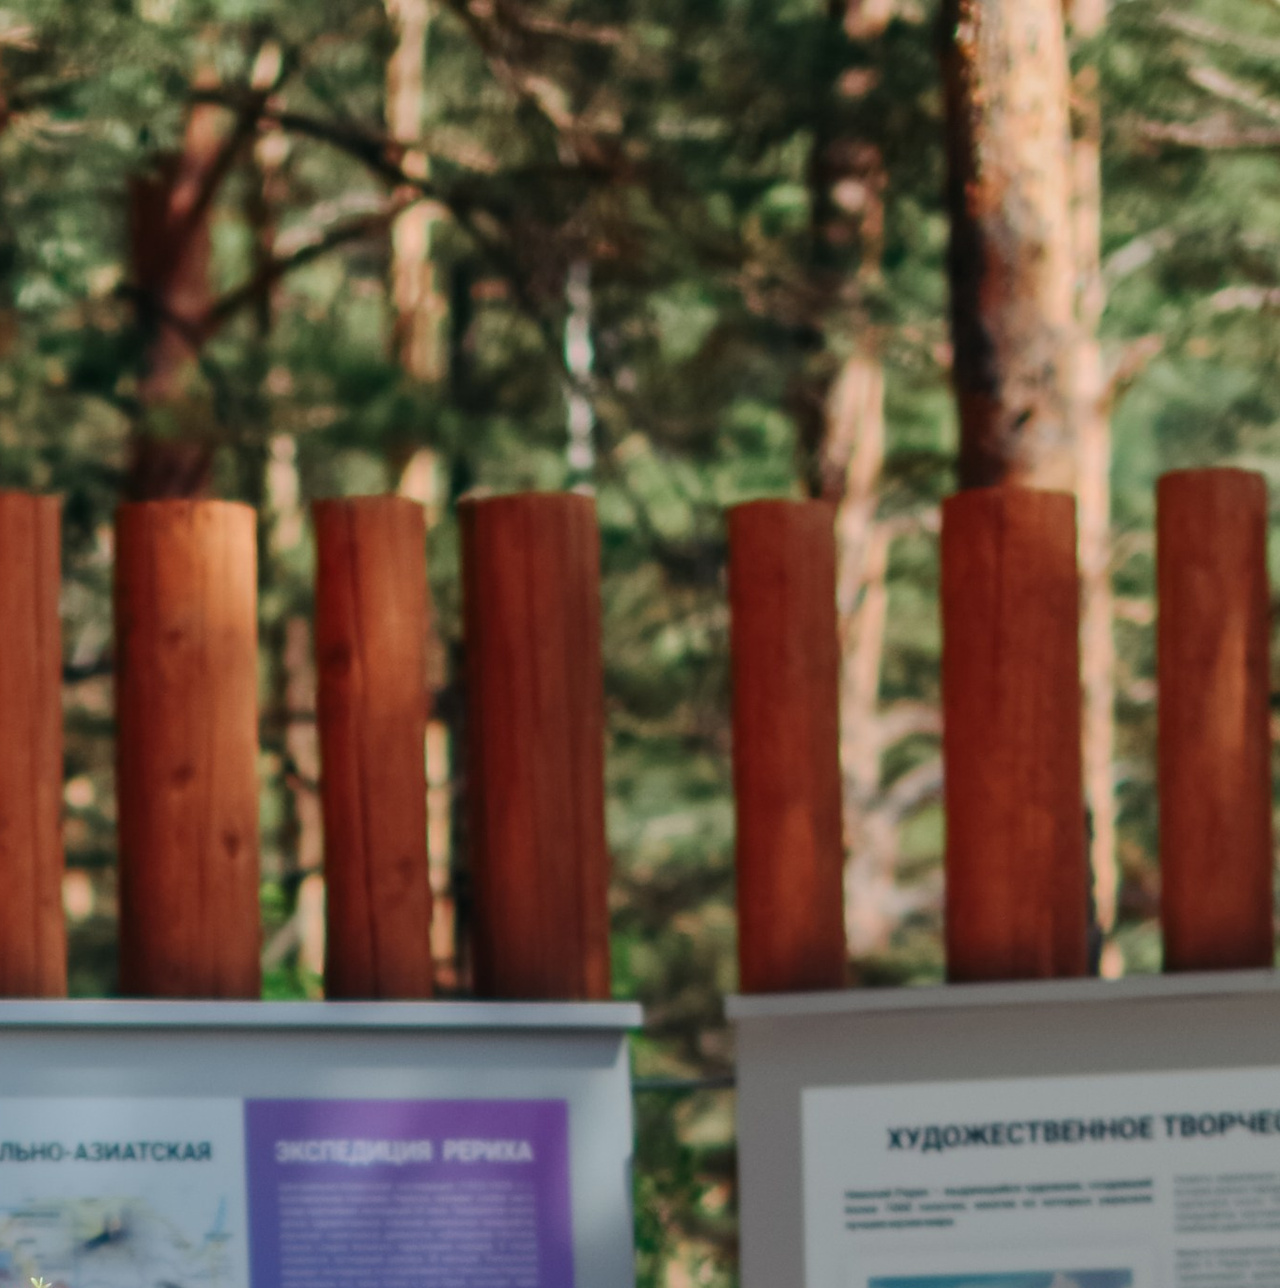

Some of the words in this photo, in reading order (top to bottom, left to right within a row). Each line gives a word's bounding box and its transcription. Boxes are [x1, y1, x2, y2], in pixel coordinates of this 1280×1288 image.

[887, 1114, 1154, 1152] ХУДОЖЕСТВЕННОЕ
[275, 1139, 433, 1167] ЭКСПЕДИЦИЯ
[442, 1138, 534, 1163] РЕРИХА
